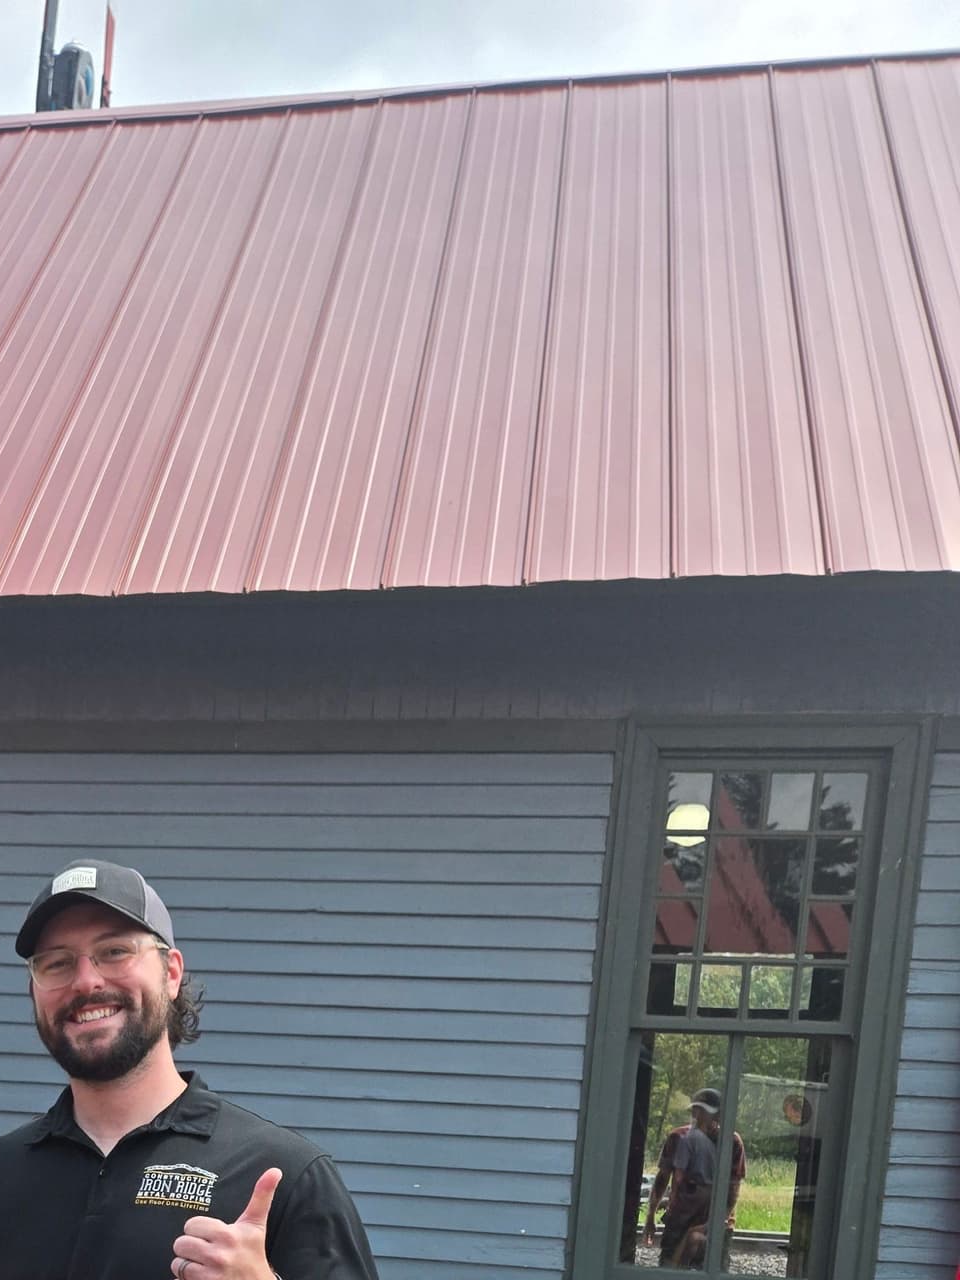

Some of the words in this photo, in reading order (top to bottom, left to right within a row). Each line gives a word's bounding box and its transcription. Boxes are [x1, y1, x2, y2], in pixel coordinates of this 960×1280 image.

[140, 1178, 172, 1193] IRON
[175, 1181, 214, 1198] RIDGE
[170, 1193, 212, 1204] ROOFING
